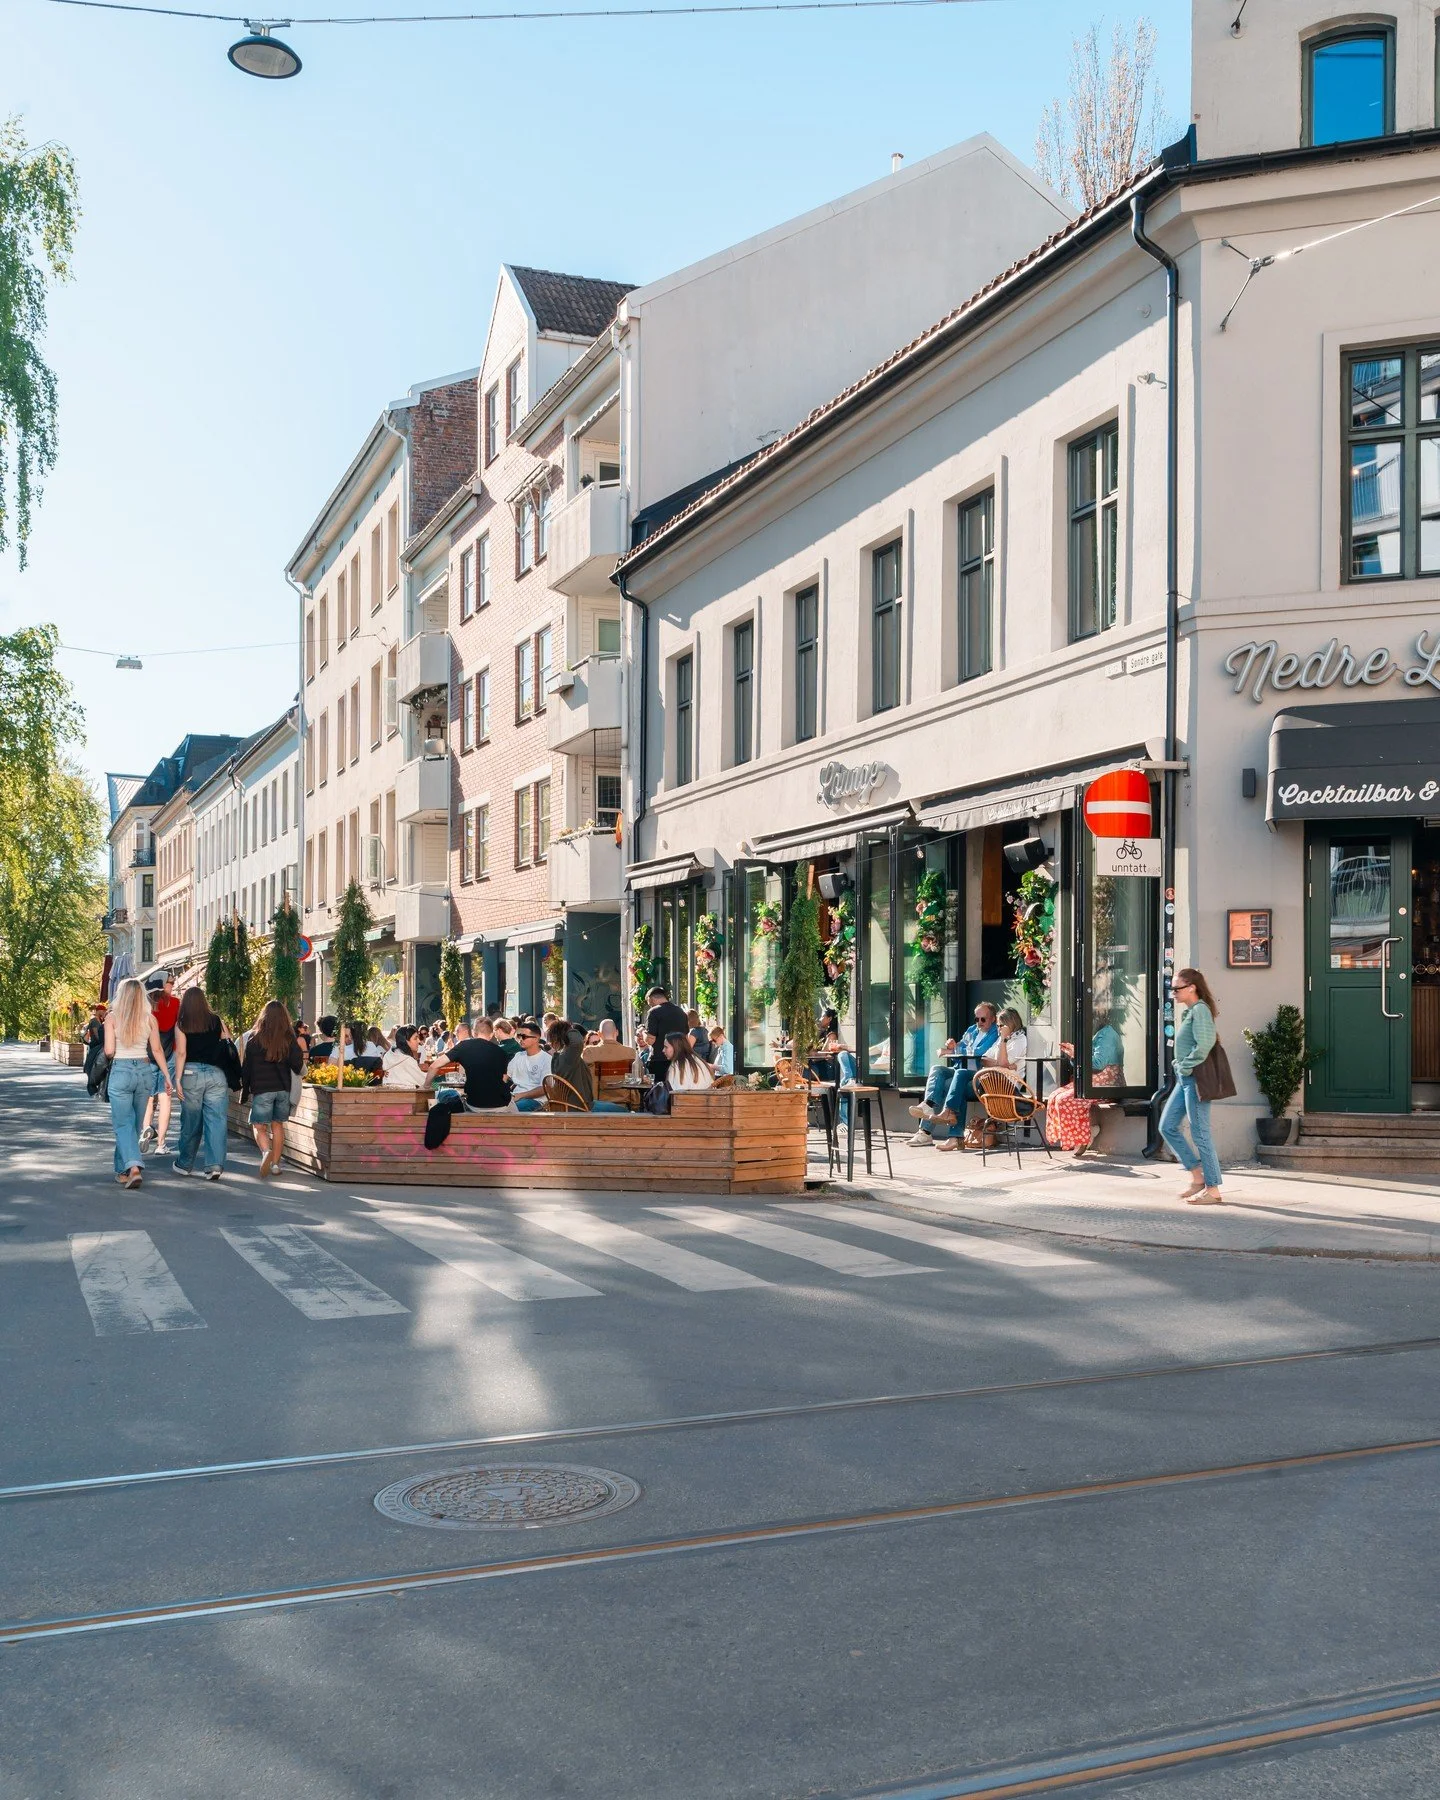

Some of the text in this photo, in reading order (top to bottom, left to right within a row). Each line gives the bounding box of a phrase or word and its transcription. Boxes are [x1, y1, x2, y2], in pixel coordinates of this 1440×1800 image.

[1225, 638, 1397, 703] Nedre
[817, 761, 888, 811] Lounge
[1278, 780, 1440, 806] Cocktailbar &
[1111, 863, 1147, 873] unntatt
